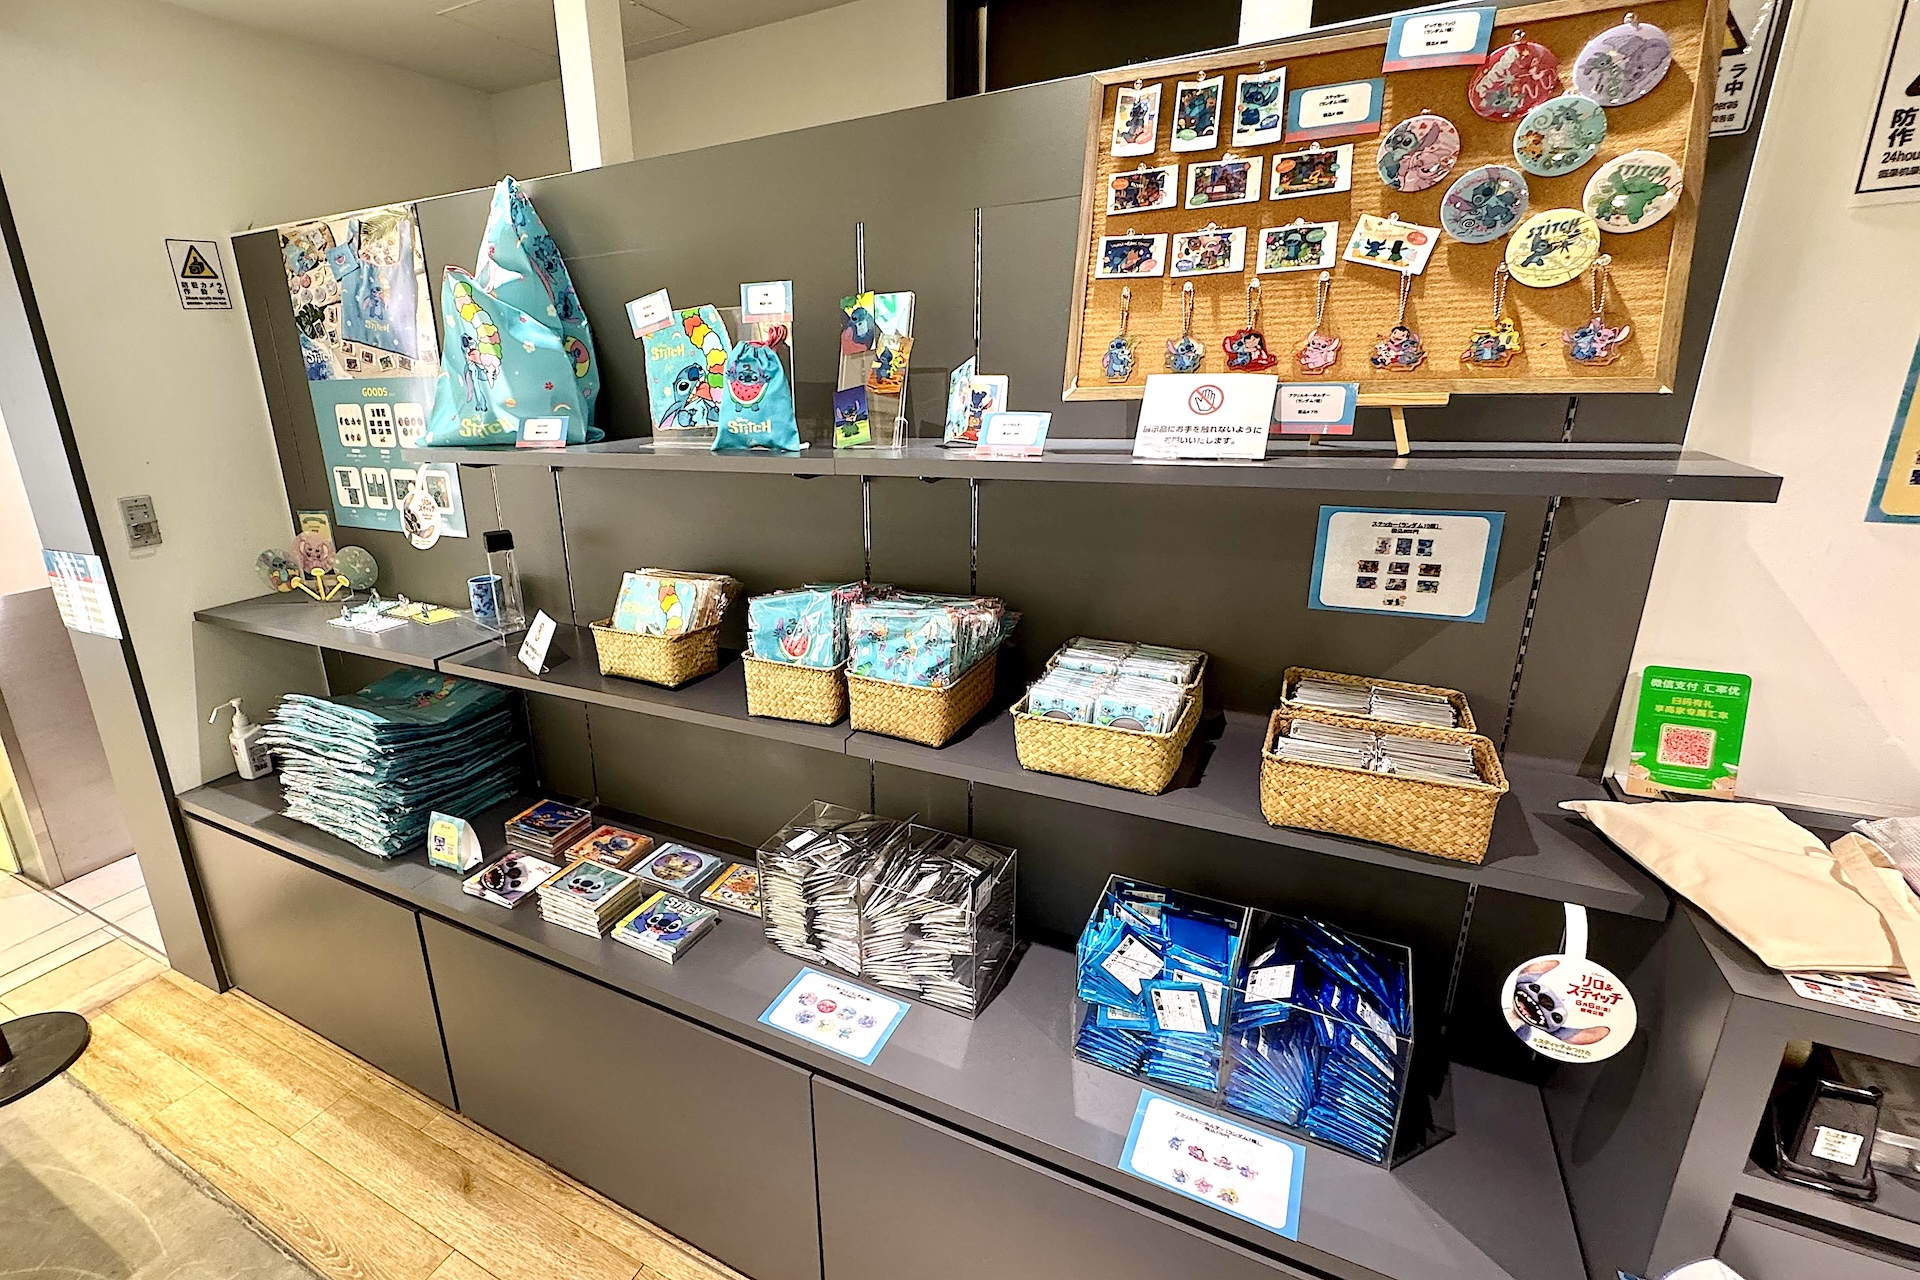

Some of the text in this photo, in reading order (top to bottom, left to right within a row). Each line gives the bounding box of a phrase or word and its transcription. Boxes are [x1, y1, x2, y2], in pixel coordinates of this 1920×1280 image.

[1724, 79, 1744, 96] 中
[1888, 128, 1915, 147] 作
[361, 386, 389, 397] GOODS
[1567, 983, 1622, 1005] スティッチ
